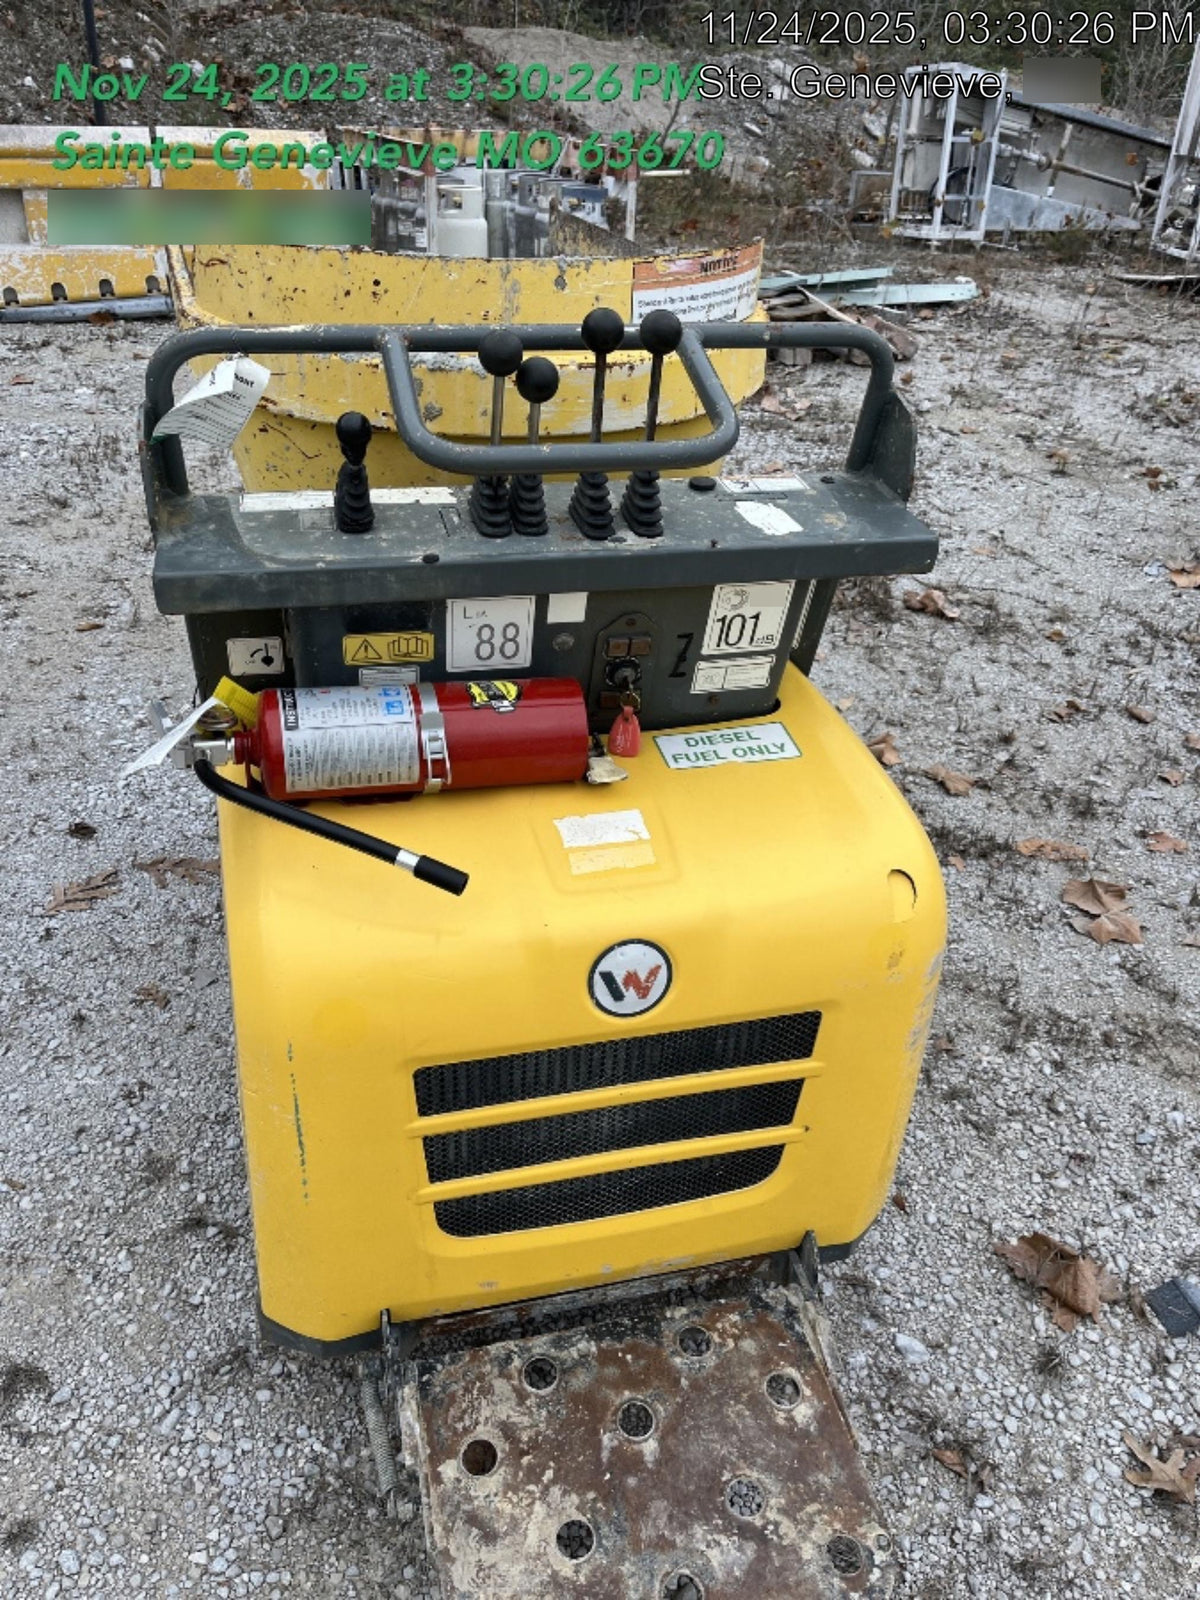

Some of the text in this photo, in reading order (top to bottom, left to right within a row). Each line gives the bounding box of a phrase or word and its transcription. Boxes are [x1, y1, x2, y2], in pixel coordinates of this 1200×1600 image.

[475, 621, 520, 661] 88
[715, 611, 761, 647] 101
[672, 742, 787, 764] FUEL ONLY
[685, 730, 761, 748] DIESEL
